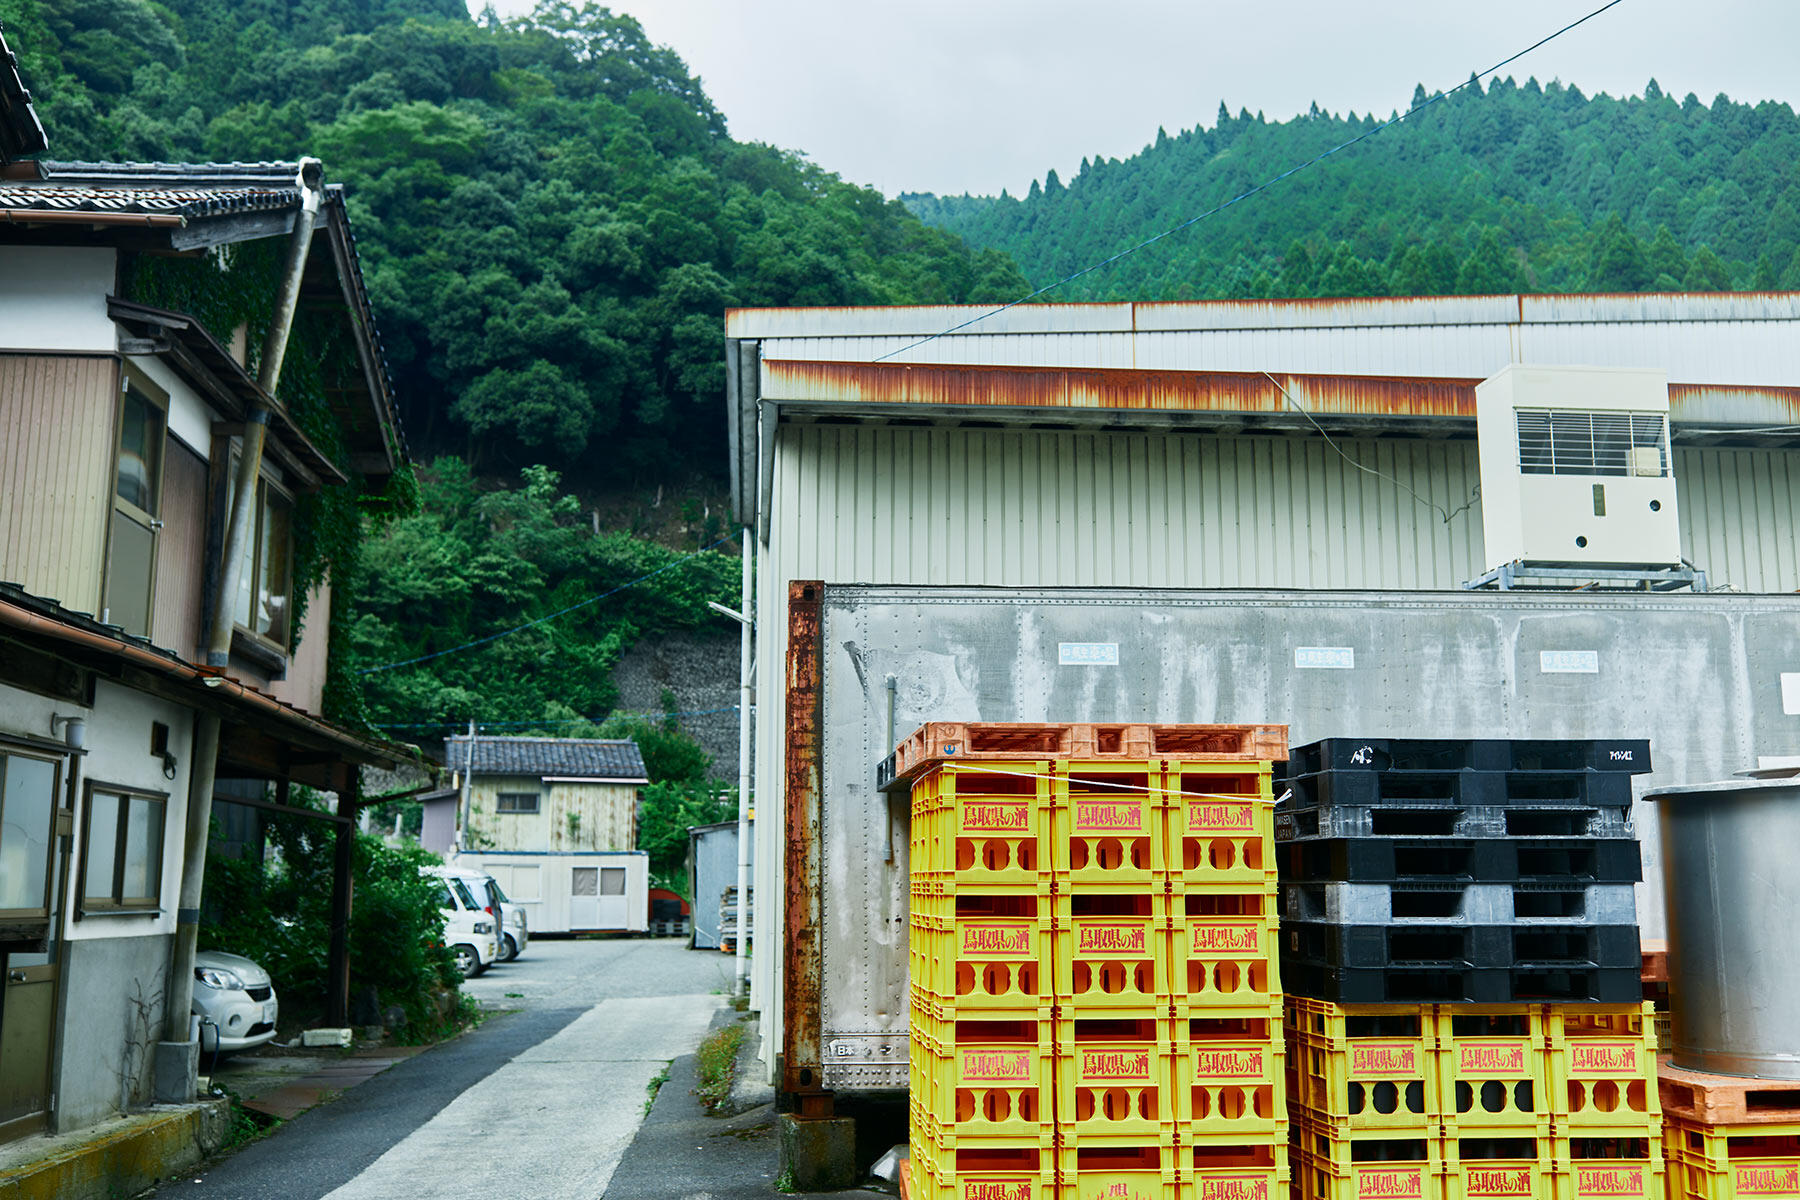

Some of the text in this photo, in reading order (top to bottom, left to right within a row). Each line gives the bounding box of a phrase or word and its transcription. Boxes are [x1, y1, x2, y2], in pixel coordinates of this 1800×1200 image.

[963, 807, 1028, 826] 鳥取県の酒
[1077, 806, 1141, 825] 鳥取県の酒
[1189, 807, 1252, 825] 鳥取県の酒
[963, 930, 1029, 949] 鳥取県の酒
[1080, 929, 1144, 948] 鳥取県の酒
[1194, 929, 1257, 948] 鳥取県の酒
[963, 1056, 1029, 1075] 鳥取県の酒
[1083, 1055, 1148, 1074] 鳥取県の酒
[1197, 1053, 1262, 1072] 鳥取県の酒
[1353, 1049, 1414, 1068] 鳥取県の酒
[1461, 1049, 1523, 1067] 鳥取県の酒
[1573, 1048, 1635, 1067] 鳥取県の酒
[1359, 1174, 1421, 1194] 鳥取県の酒
[1468, 1172, 1530, 1192] 鳥取県の酒
[1579, 1172, 1642, 1191] 鳥取県の酒
[1737, 1170, 1798, 1191] 鳥取県の酒
[1203, 1181, 1267, 1200] 鳥取県の酒
